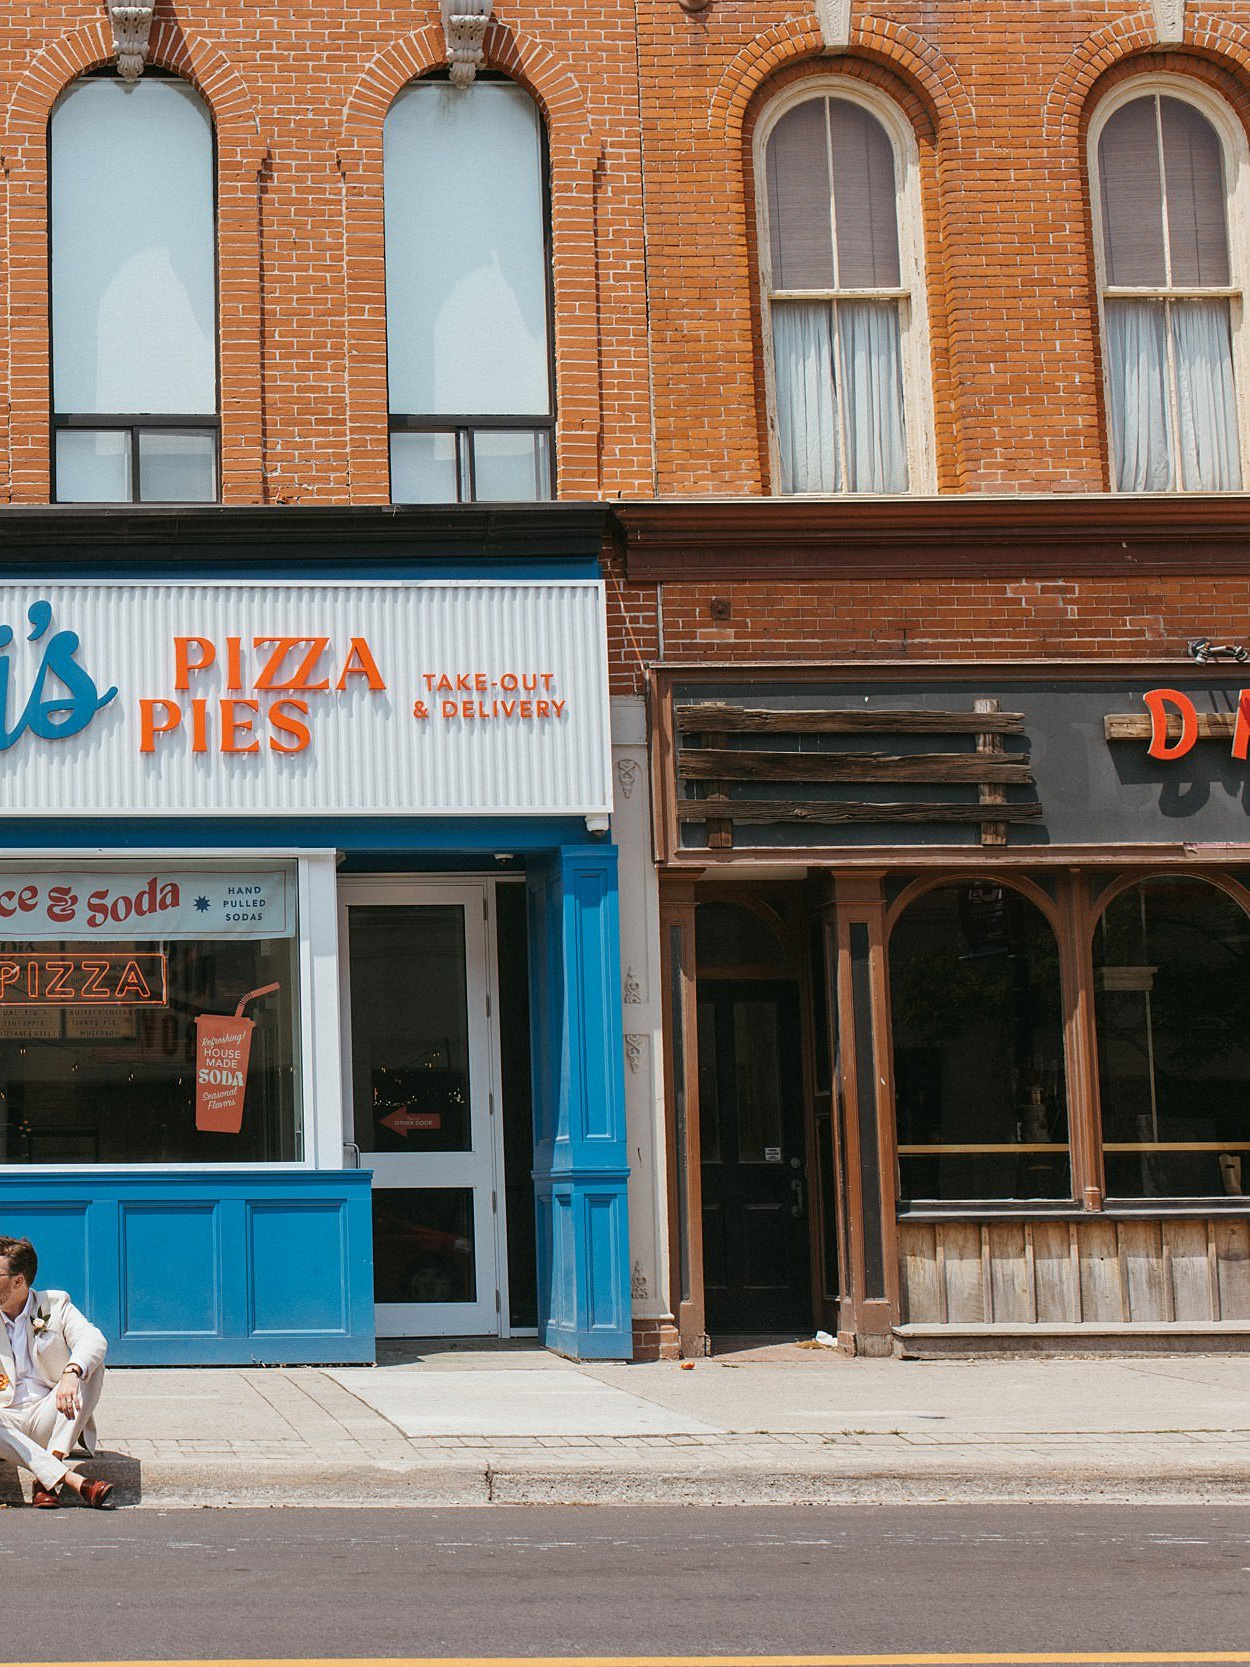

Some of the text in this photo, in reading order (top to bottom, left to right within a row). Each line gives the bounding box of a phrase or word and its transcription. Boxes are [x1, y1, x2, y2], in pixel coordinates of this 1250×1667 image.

[173, 637, 387, 691] PIZZA
[423, 673, 555, 693] TAKE-OUT
[413, 700, 567, 720] & DELIVERY
[139, 699, 312, 754] PIES
[227, 886, 262, 895] HAND
[47, 886, 79, 923] &
[86, 876, 181, 929] Soda
[223, 899, 266, 908] PULLED
[225, 912, 264, 922] SODAS
[201, 1030, 247, 1049] Refreshing!
[203, 1048, 241, 1059] HOUSE
[205, 1058, 238, 1068] MADE
[198, 1068, 244, 1086] SODA
[202, 1086, 238, 1101] Seasonal
